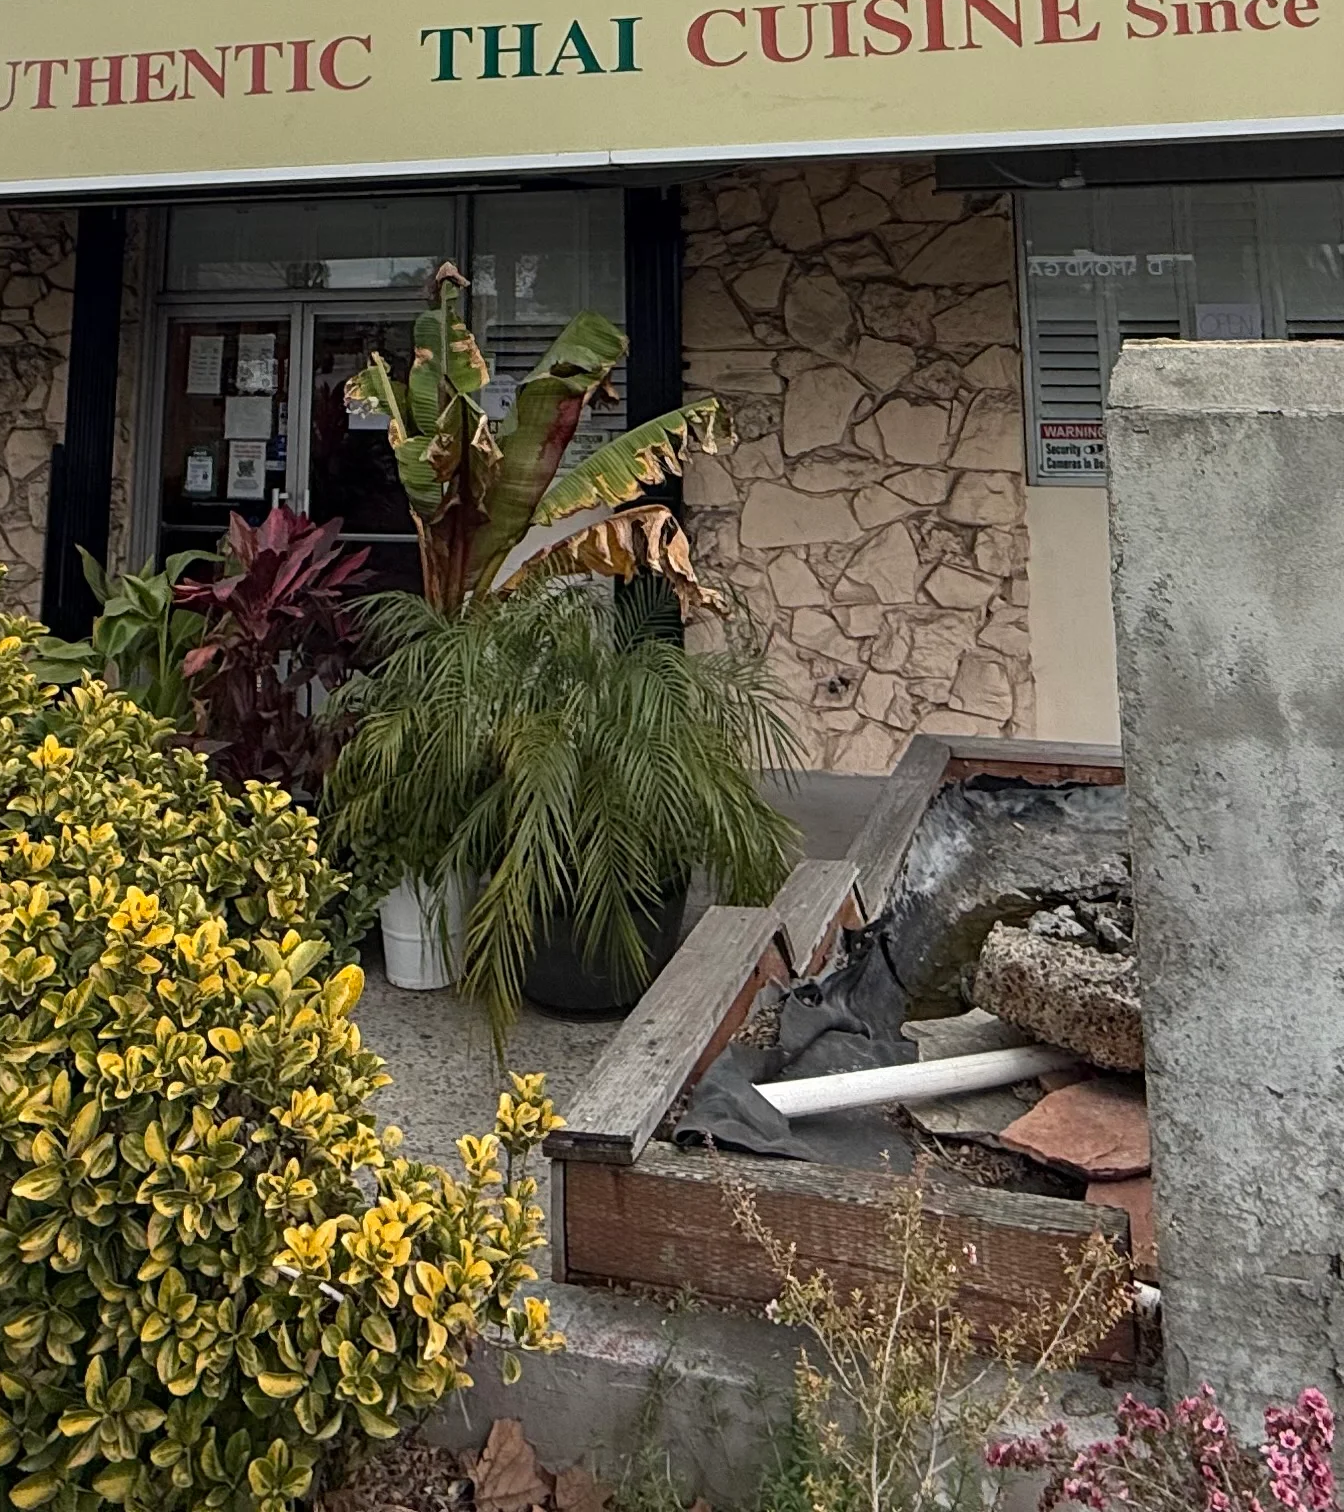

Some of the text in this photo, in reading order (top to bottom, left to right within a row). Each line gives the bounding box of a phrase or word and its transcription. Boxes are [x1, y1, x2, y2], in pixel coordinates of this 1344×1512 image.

[420, 17, 643, 81] THAI
[1200, 312, 1253, 336] OPEN
[1046, 442, 1081, 457] Security
[1046, 457, 1082, 469] Cameras
